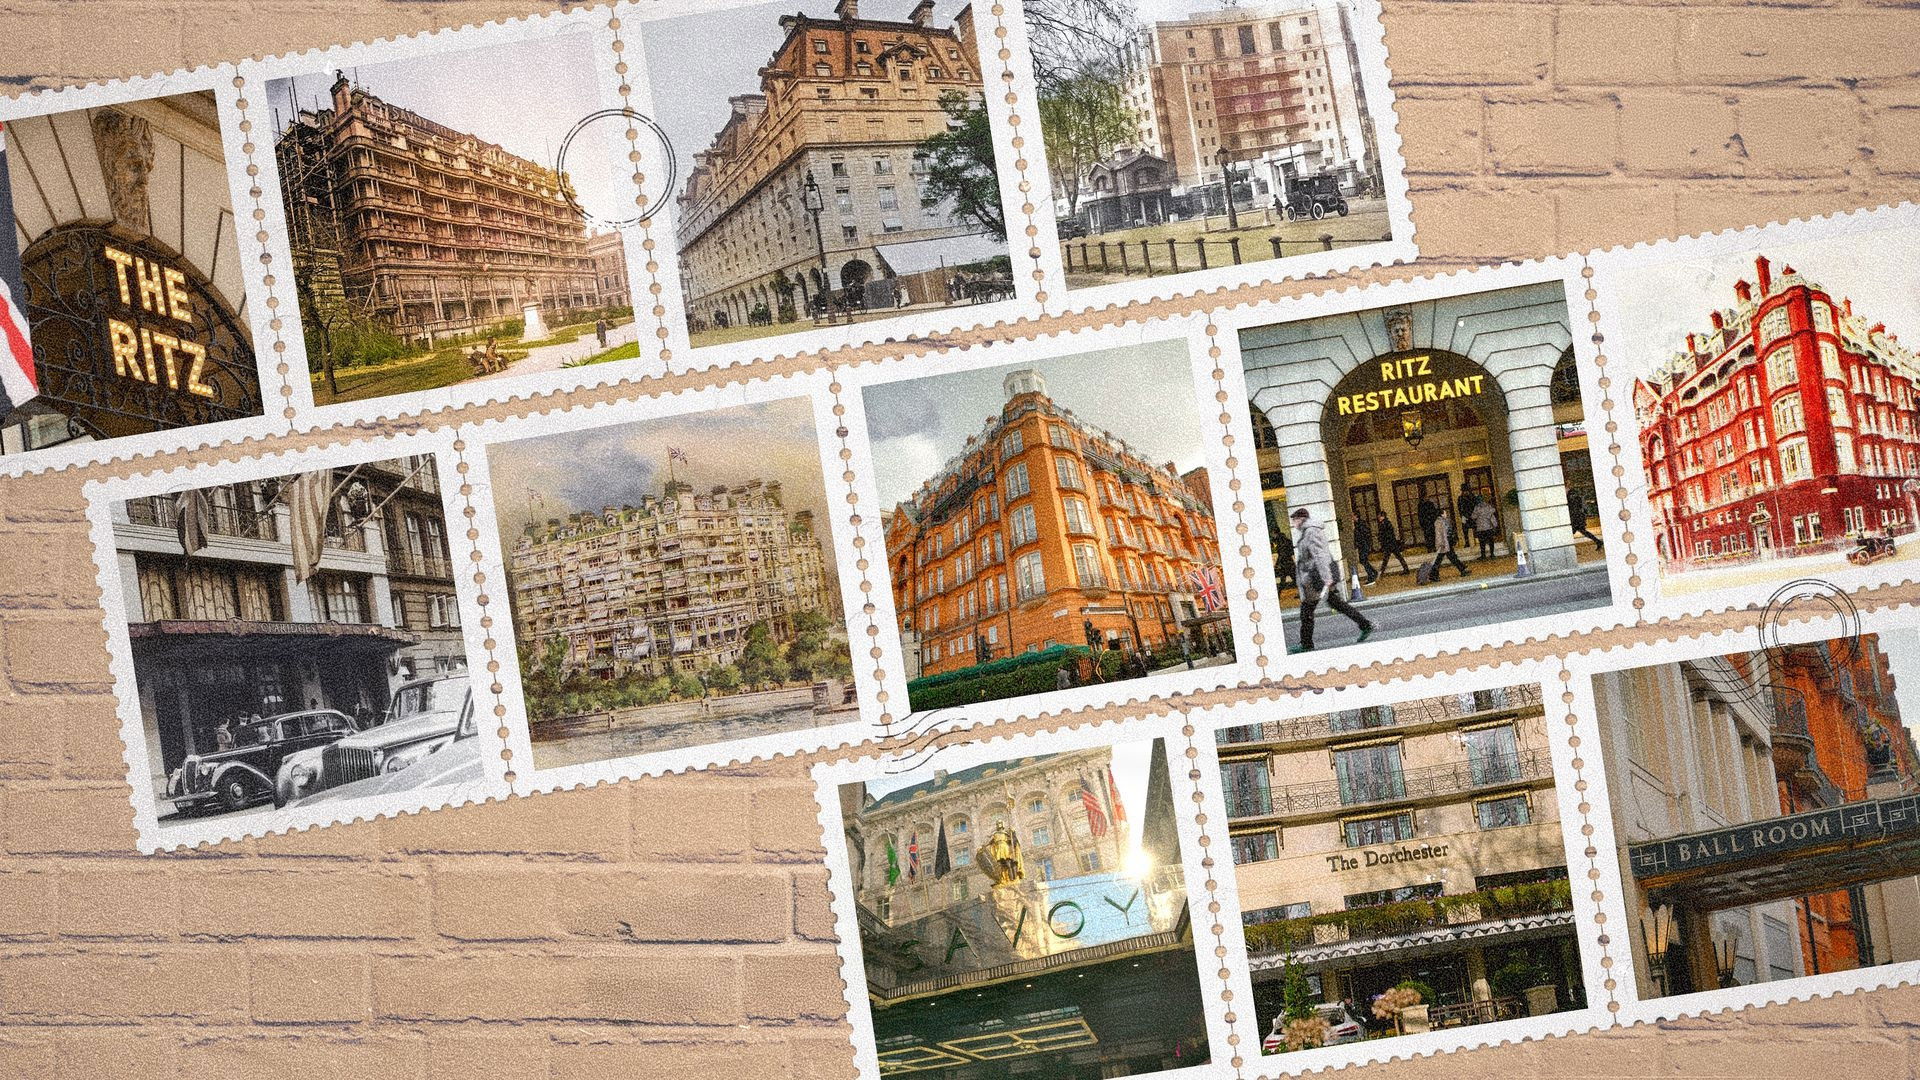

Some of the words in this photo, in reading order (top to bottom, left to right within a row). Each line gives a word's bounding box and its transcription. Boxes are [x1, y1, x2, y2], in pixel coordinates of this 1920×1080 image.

[388, 107, 428, 129] SAVOY
[105, 246, 192, 323] THE
[109, 318, 214, 398] RITZ
[1381, 356, 1432, 381] RITZ
[1337, 375, 1484, 416] RESTAURANT
[1326, 855, 1358, 873] The
[1364, 845, 1449, 868] Dorchester
[1678, 834, 1744, 862] BALL
[1751, 816, 1831, 848] ROOM
